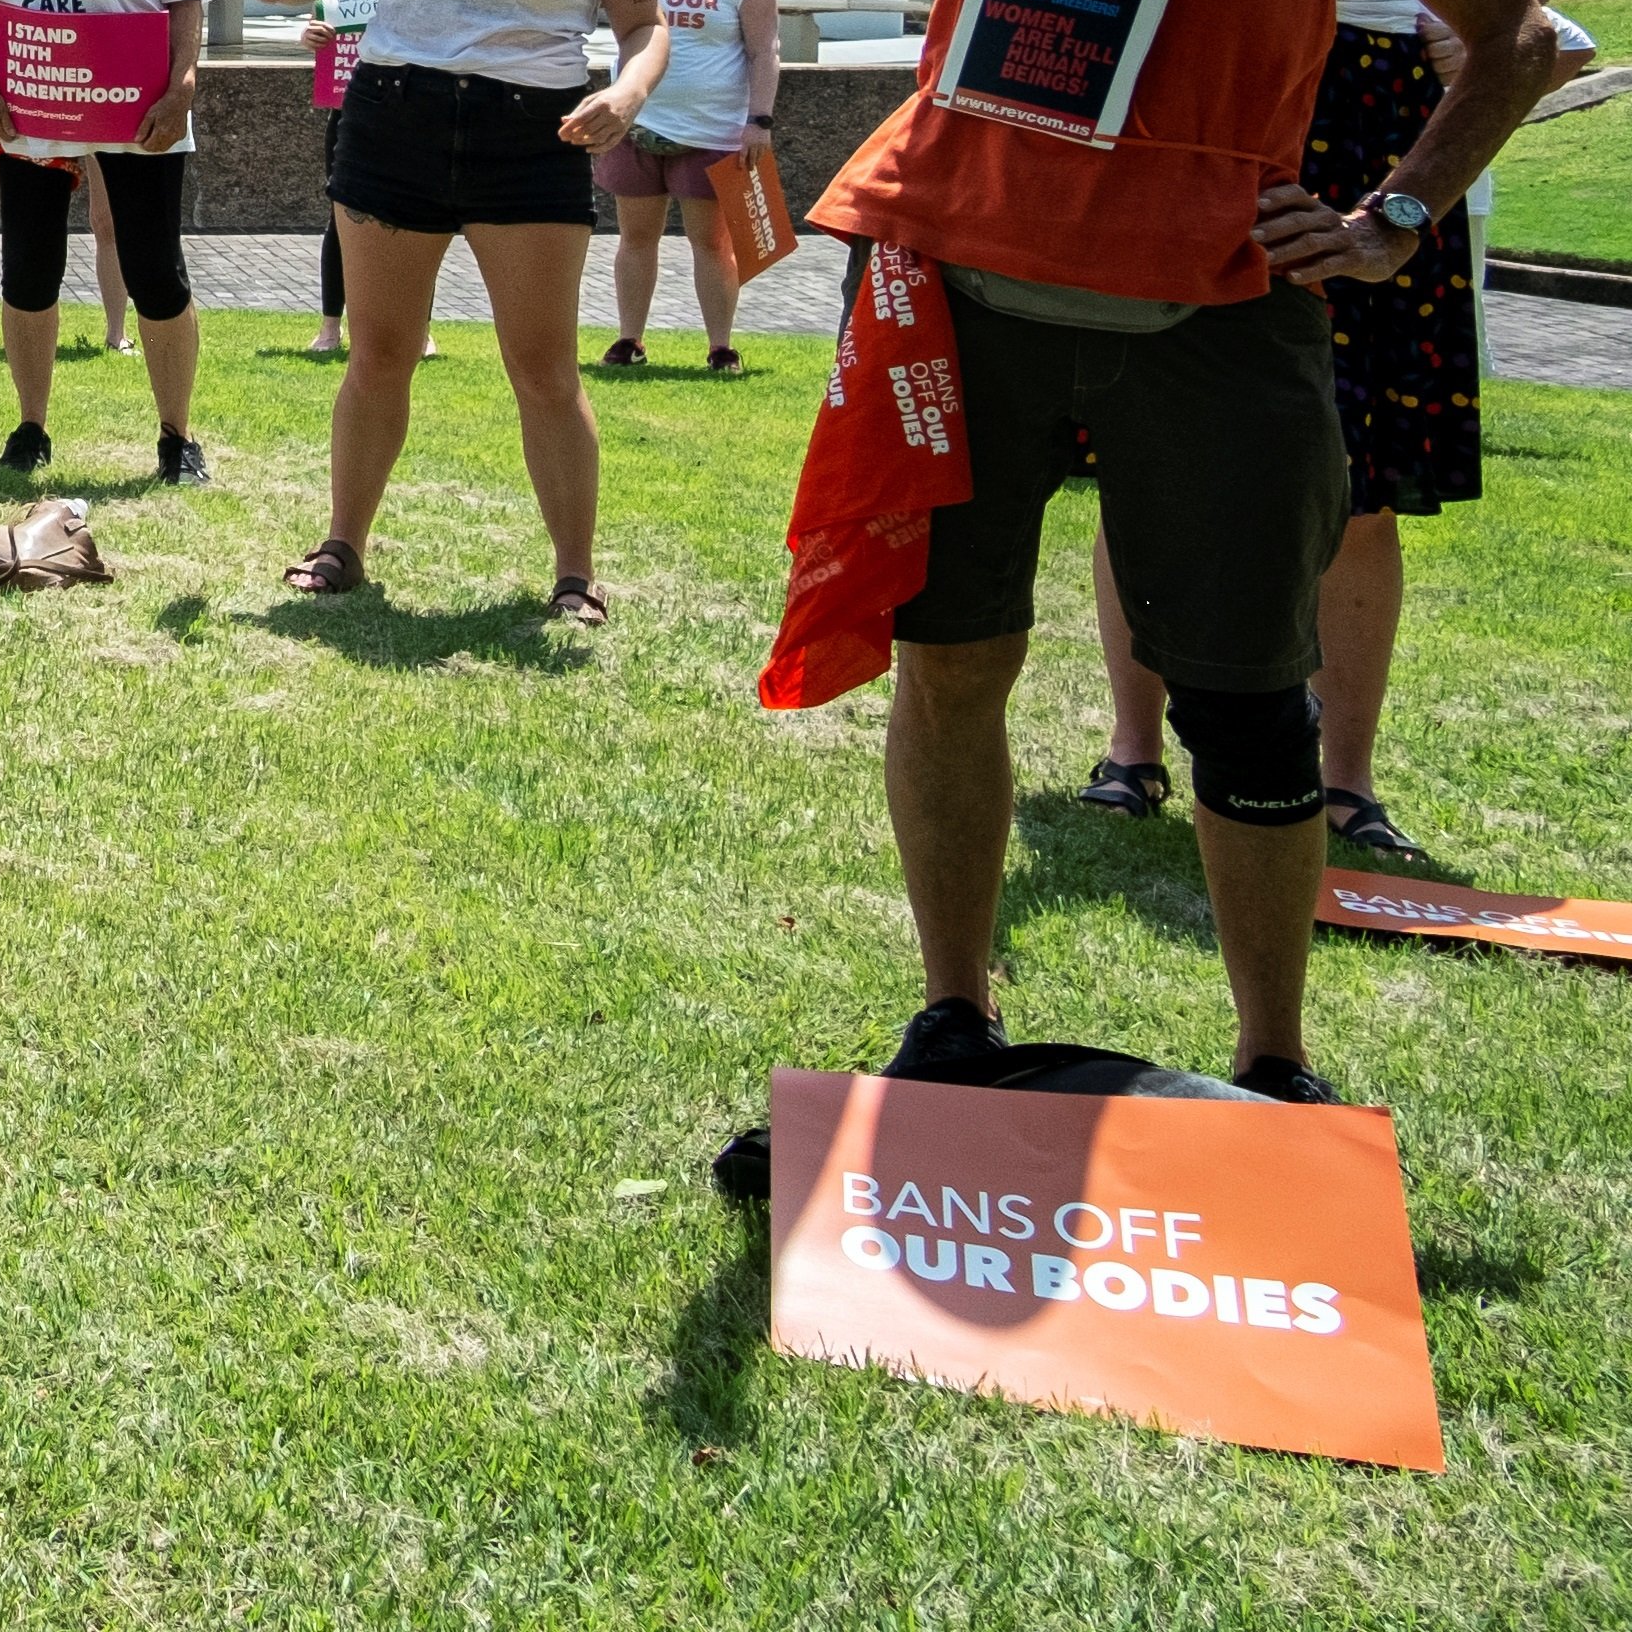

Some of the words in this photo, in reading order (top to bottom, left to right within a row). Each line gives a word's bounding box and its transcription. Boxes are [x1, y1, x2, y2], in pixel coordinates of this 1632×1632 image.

[7, 21, 12, 37] I
[15, 23, 77, 45] STAND
[7, 40, 52, 62] WITH
[1011, 26, 1055, 50] ARE
[1060, 37, 1114, 65] FULL
[6, 59, 93, 84] PLANNED
[999, 61, 1090, 97] BEINGS!
[1005, 43, 1089, 78] HUMAN
[955, 94, 1091, 137] www.revcom.us
[749, 165, 768, 216] BODIE
[751, 218, 768, 260] BANS
[761, 214, 776, 252] OUR
[902, 246, 928, 287] ANS
[888, 279, 915, 328] OUR
[909, 361, 936, 402] OFF
[929, 357, 959, 414] BANS
[887, 365, 926, 448] BODIES
[921, 406, 951, 457] OUR
[1238, 789, 1319, 809] MUELLER
[1332, 888, 1466, 917] BANS
[1477, 910, 1581, 929] OFF
[1339, 900, 1464, 924] OUR
[841, 1170, 1037, 1241] BANS
[1053, 1200, 1202, 1259] OFF
[839, 1225, 1013, 1294] OUR
[1032, 1251, 1342, 1336] BODIES
